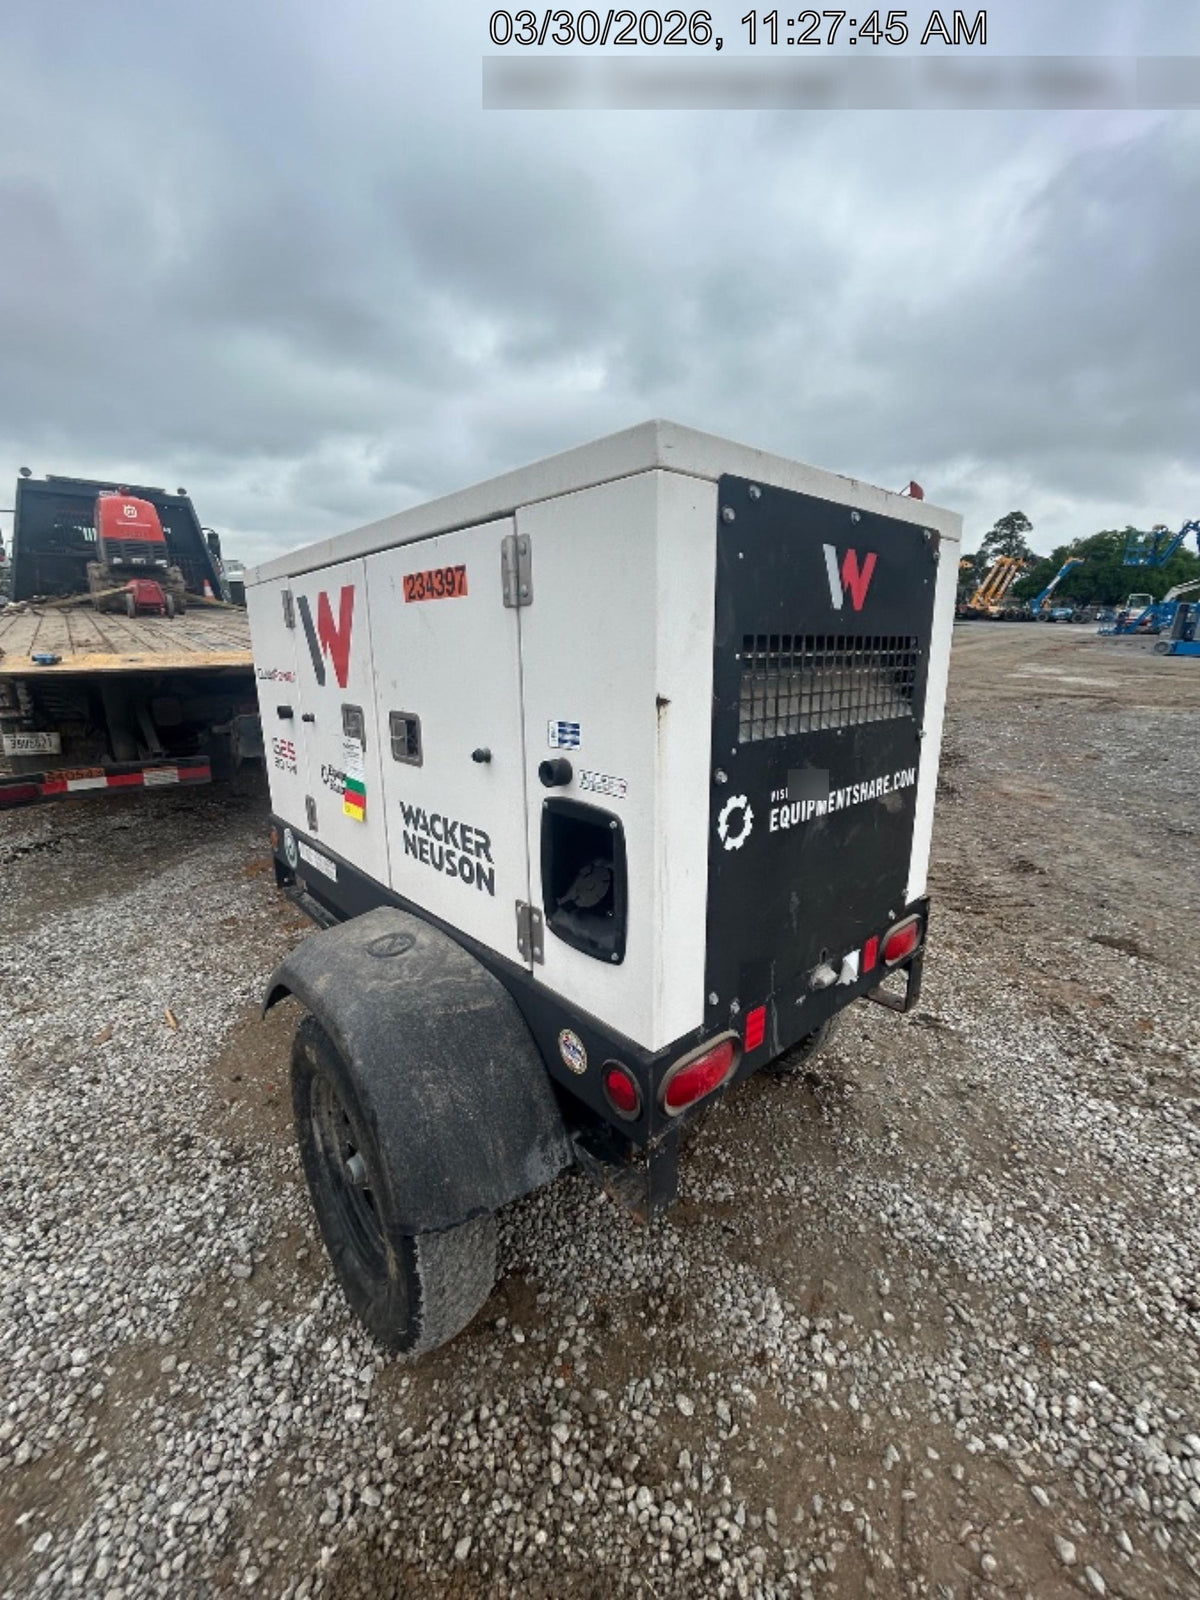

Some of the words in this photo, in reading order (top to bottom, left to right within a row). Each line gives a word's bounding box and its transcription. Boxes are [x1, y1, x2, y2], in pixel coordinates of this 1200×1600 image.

[407, 564, 467, 600] 234397
[399, 800, 495, 865] WACKER
[769, 767, 916, 833] EQUIPMENTSHARE.COM
[402, 829, 496, 897] NEUSON
